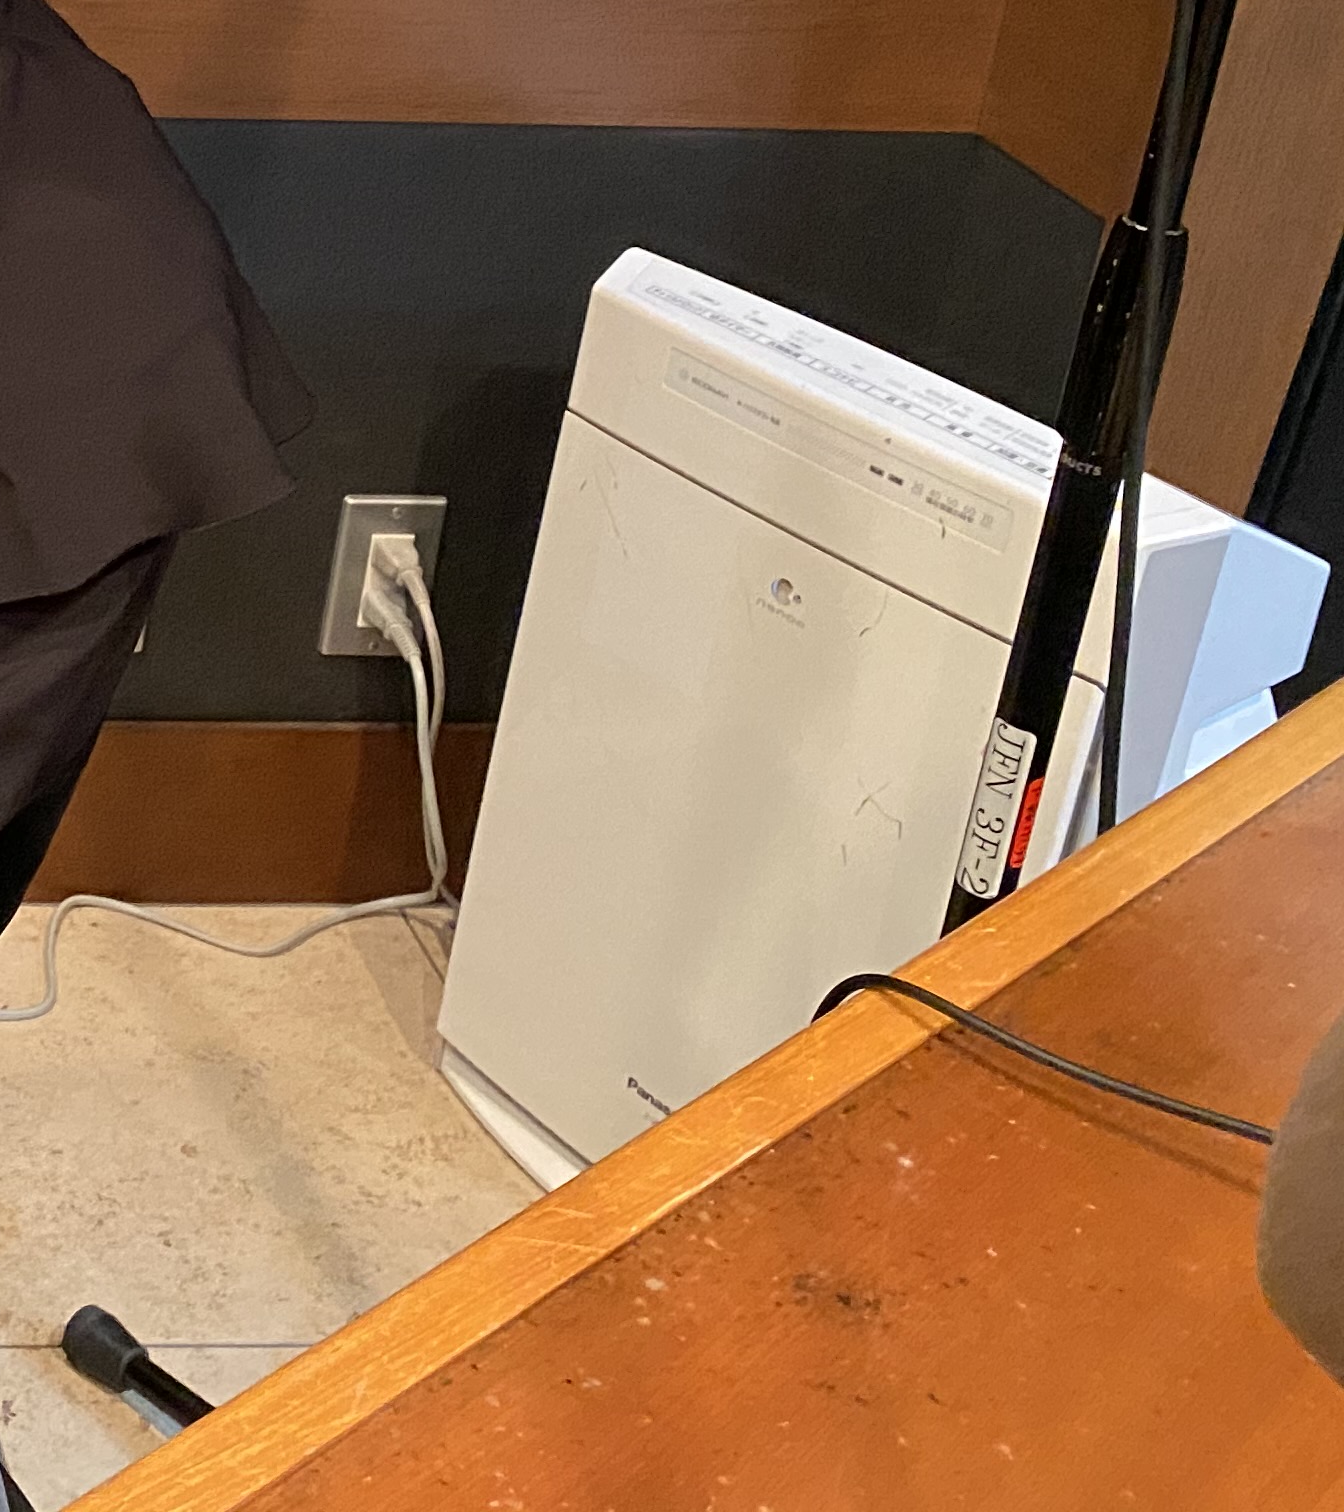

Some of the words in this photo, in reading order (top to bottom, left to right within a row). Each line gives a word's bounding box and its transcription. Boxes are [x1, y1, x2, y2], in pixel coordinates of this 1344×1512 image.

[986, 722, 1027, 800] JFN
[961, 807, 1005, 895] 3F-2
[626, 1076, 672, 1117] Panas
